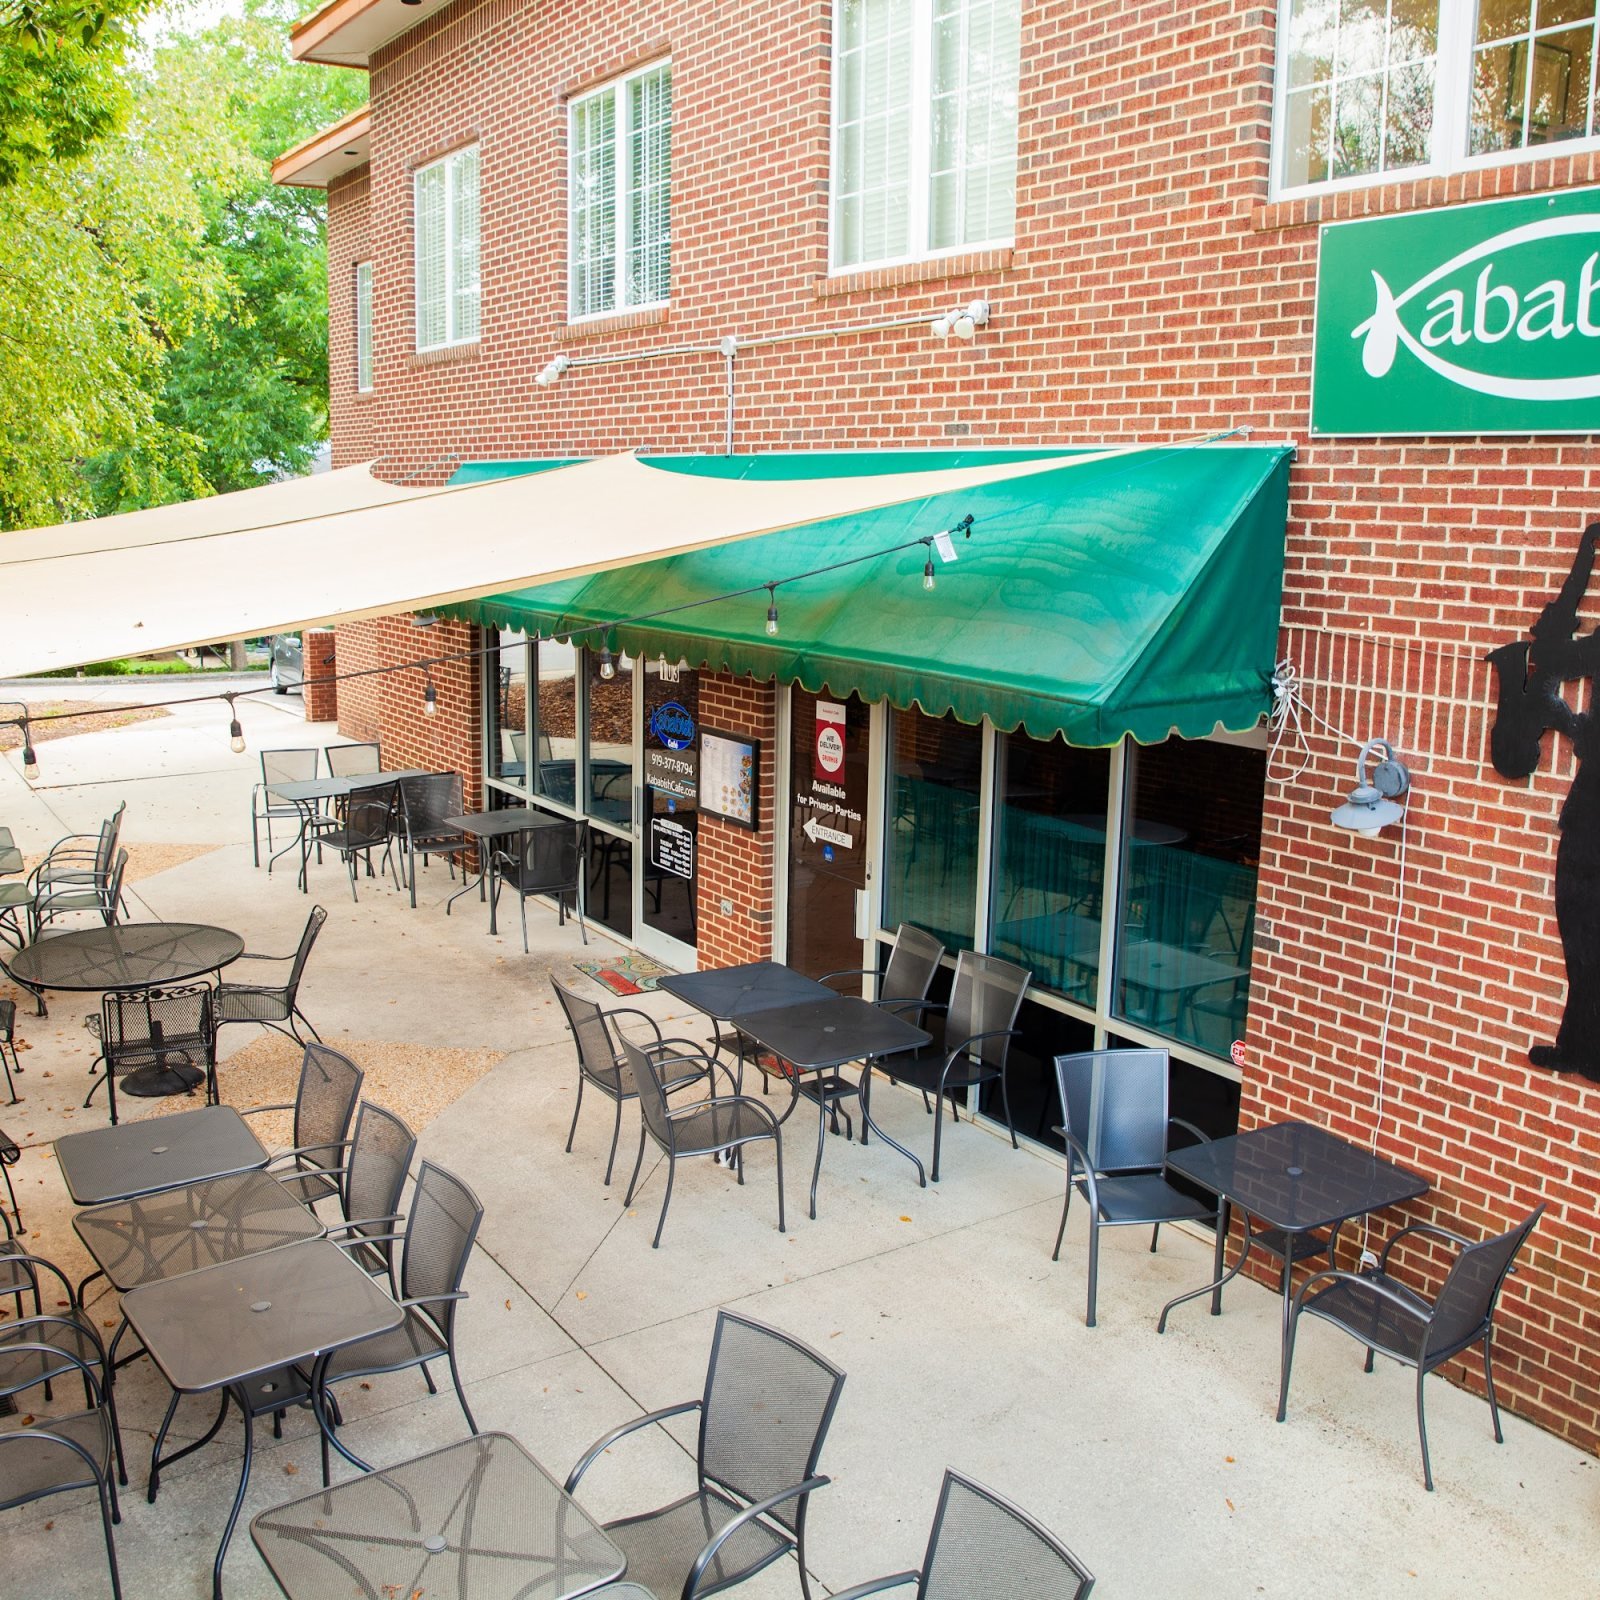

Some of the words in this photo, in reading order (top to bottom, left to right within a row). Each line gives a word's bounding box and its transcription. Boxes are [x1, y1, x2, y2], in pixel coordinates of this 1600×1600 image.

[660, 661, 679, 682] 103
[651, 753, 694, 777] 919-377-8794
[646, 772, 697, 798] KababishCafe.com
[812, 780, 846, 799] Available
[797, 793, 807, 804] for
[809, 796, 833, 813] Private
[835, 804, 862, 821] Parties
[811, 825, 846, 844] ENTRANCE
